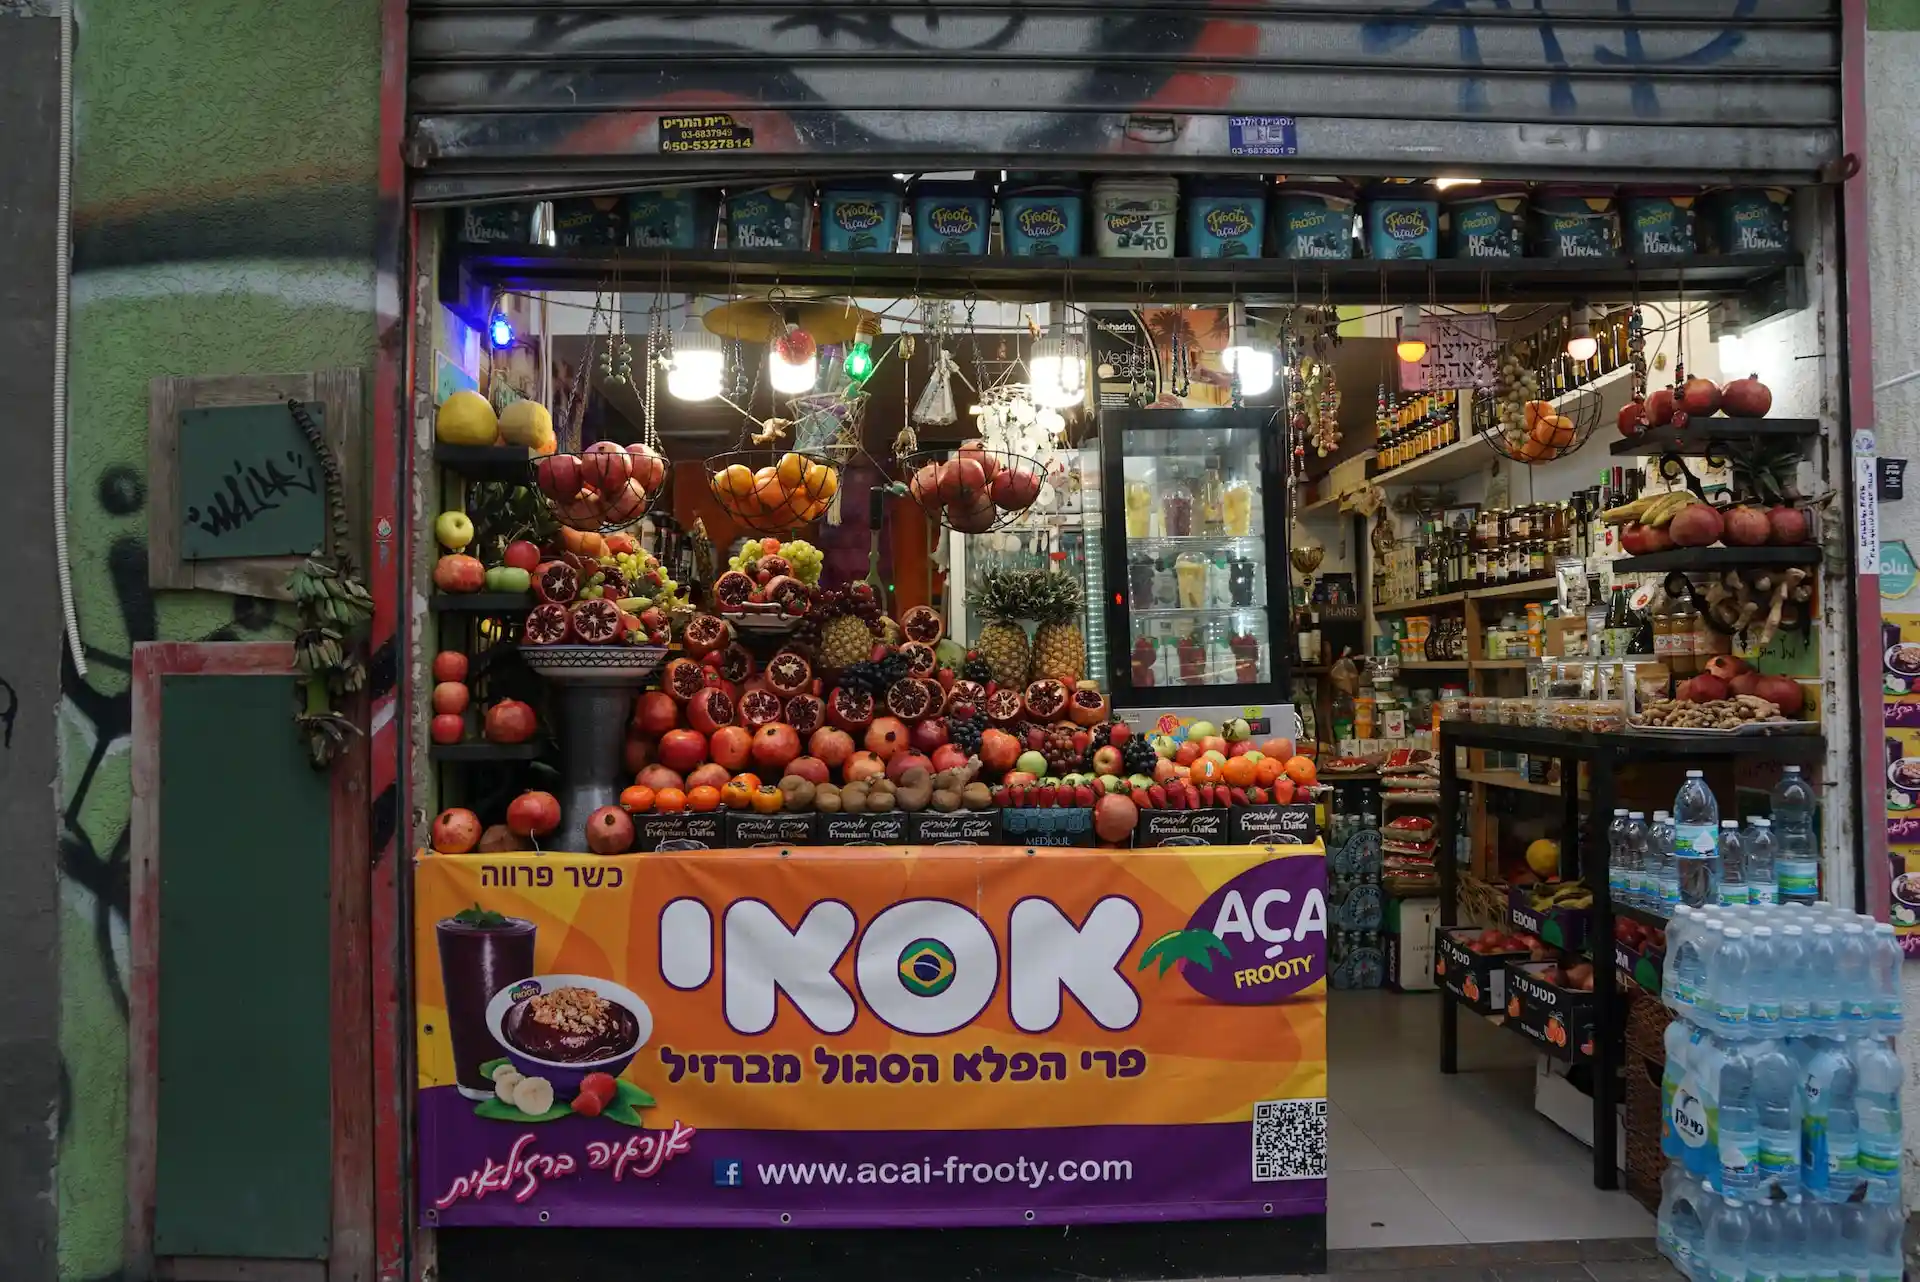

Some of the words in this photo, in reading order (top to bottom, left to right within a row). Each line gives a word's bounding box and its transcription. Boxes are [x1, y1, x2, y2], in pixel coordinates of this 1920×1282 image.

[932, 207, 977, 232] Frooty
[1019, 208, 1066, 232] Frooty
[1141, 222, 1165, 236] ZE
[1207, 205, 1253, 231] Frooty
[1385, 209, 1429, 233] Frooty
[1144, 237, 1168, 250] RO
[1325, 607, 1358, 618] PLANTS
[646, 829, 689, 838] Premium
[690, 828, 715, 837] Dates
[738, 831, 778, 839] Premium
[781, 830, 807, 839] Dates
[829, 829, 870, 838] Premium
[873, 828, 899, 838] Dates
[921, 829, 961, 838] Premium
[964, 828, 990, 837] Dates
[1150, 825, 1189, 833] Premium
[1192, 824, 1217, 833] Dates
[1242, 822, 1281, 830] Premium
[1283, 820, 1307, 830] Dates
[481, 864, 554, 888] פרווה
[565, 865, 623, 888] כשר
[1512, 909, 1539, 932] EDOM
[658, 895, 1143, 1036] אסאי
[1233, 953, 1312, 989] FROOTY
[660, 1046, 801, 1084] מברזיל
[814, 1046, 939, 1085] הסגול
[953, 1045, 1067, 1084] הפלא
[1080, 1048, 1147, 1079] פרי
[586, 1119, 696, 1182] אנרגיה
[435, 1132, 576, 1209] ברזילאית
[758, 1155, 1133, 1188] www.acai-frooty.com
